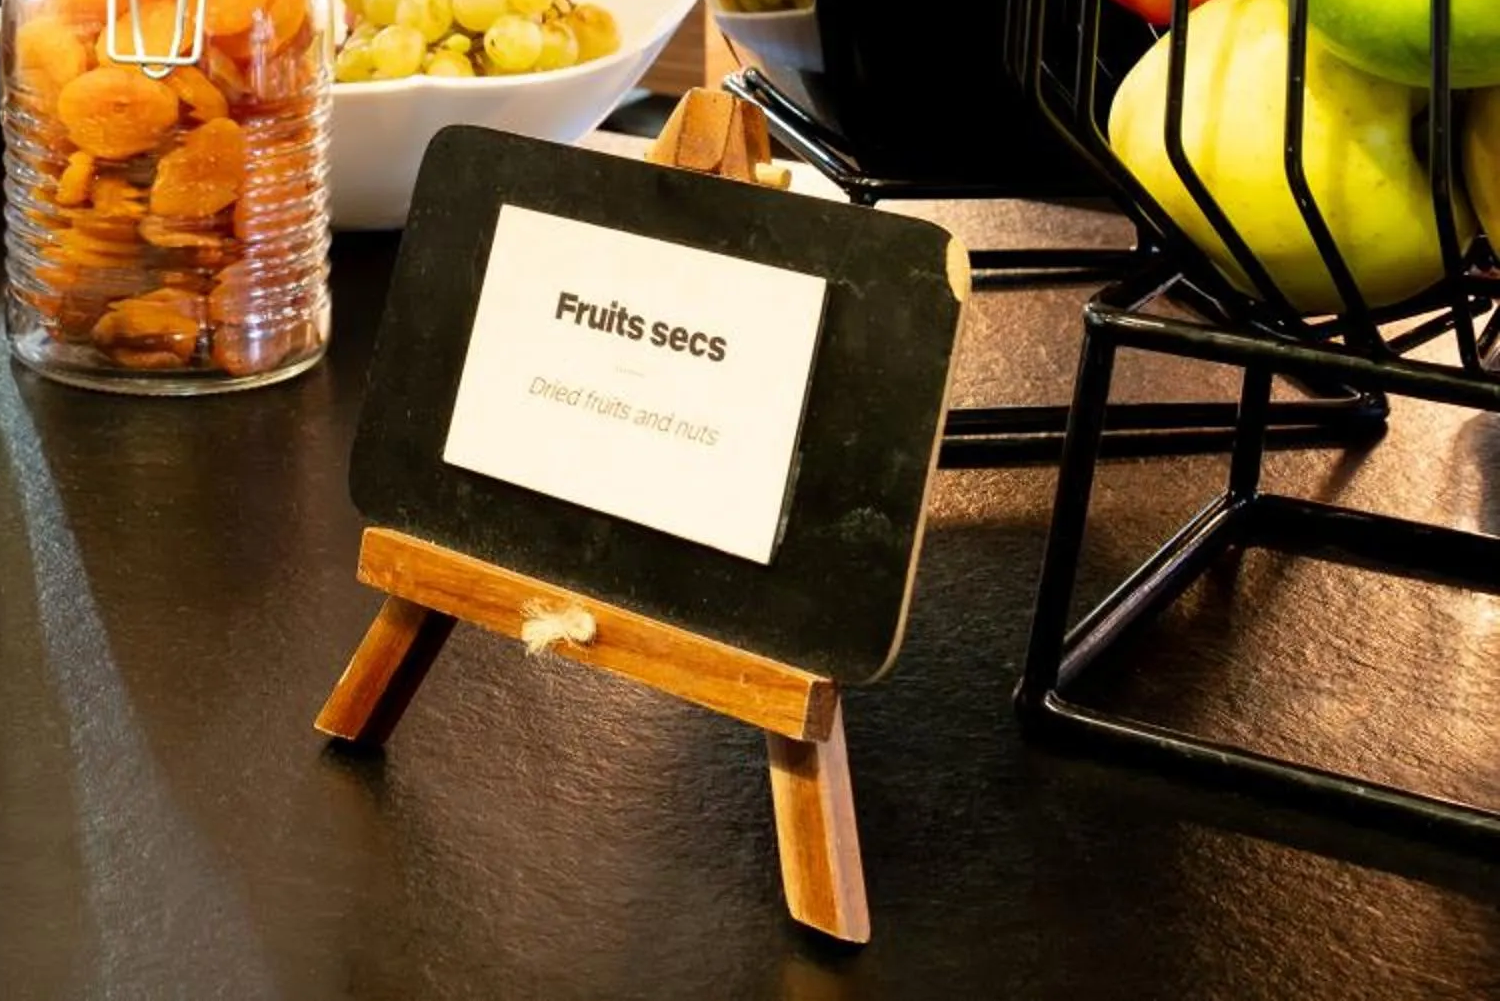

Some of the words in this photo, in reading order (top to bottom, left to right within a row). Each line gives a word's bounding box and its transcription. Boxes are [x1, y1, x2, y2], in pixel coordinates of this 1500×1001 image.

[555, 291, 646, 341] Fruits
[650, 320, 727, 362] secs
[528, 375, 584, 407] Dried
[583, 390, 633, 421] fruits
[632, 408, 676, 433] and
[674, 420, 720, 447] nuts
